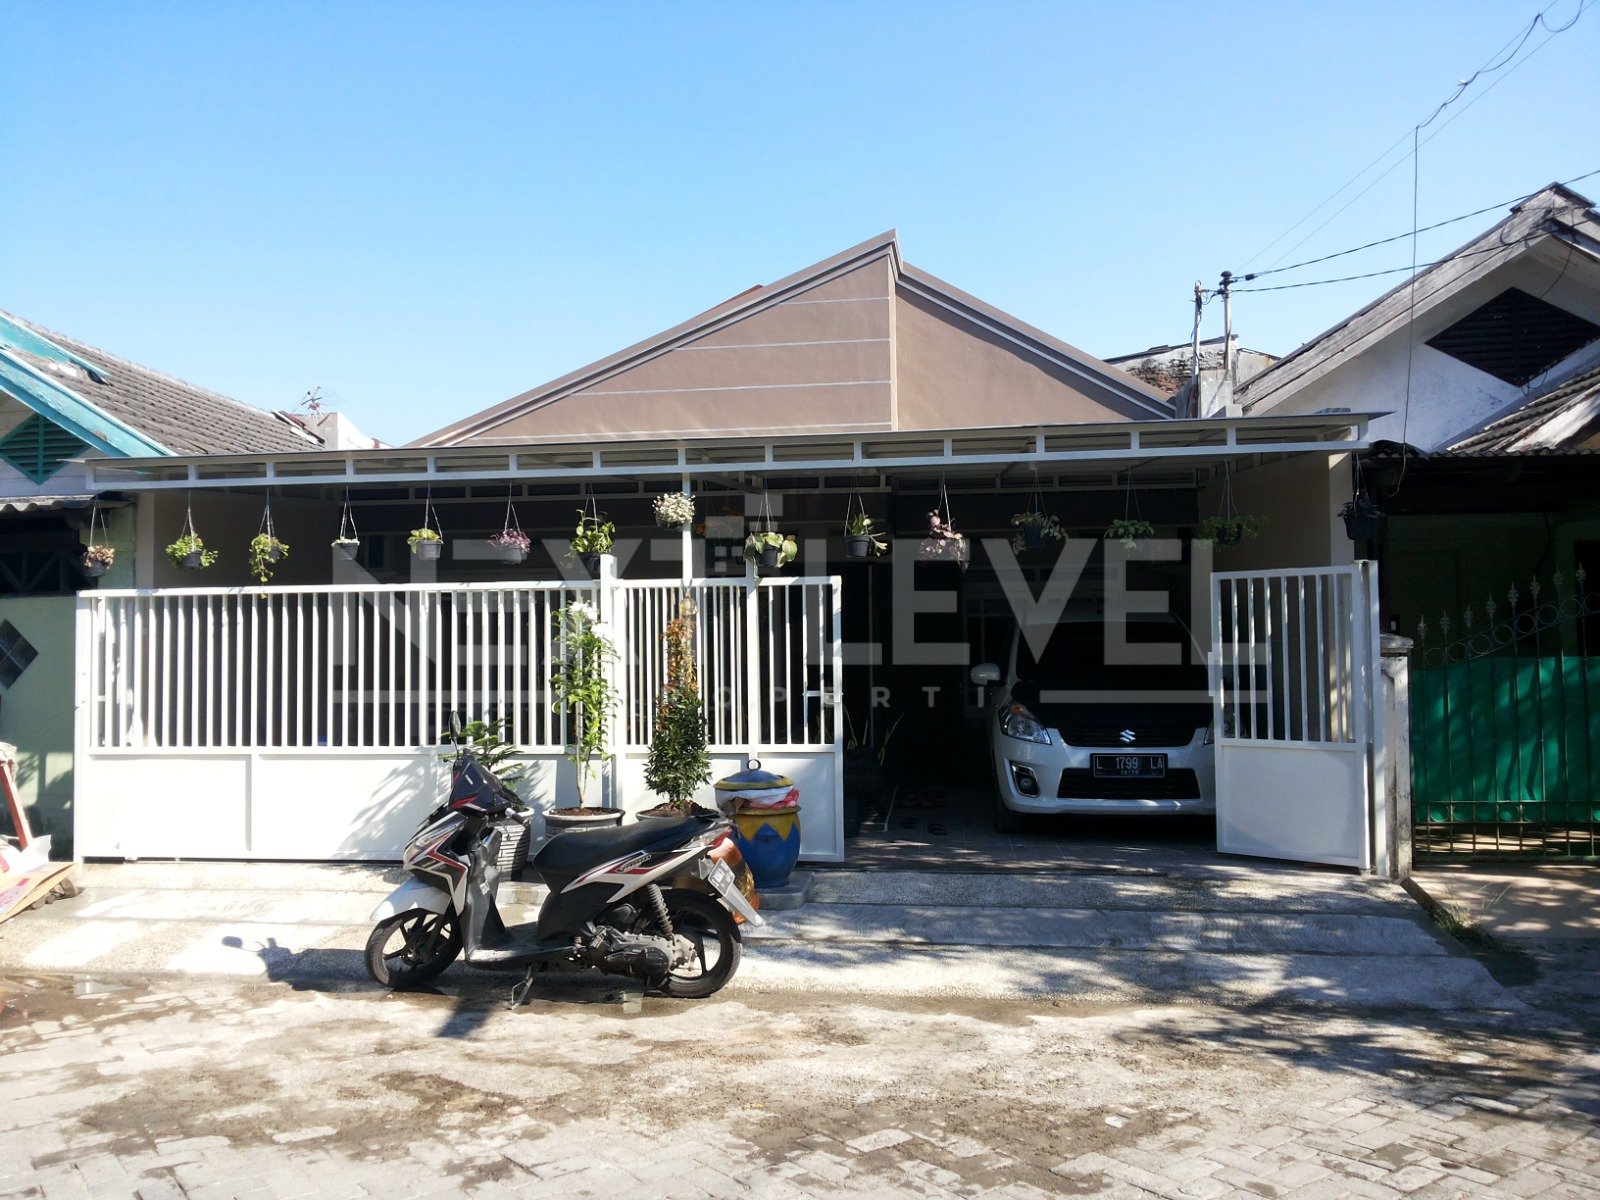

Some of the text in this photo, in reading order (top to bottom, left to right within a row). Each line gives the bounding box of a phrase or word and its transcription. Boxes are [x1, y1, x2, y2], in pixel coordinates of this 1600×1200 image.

[1096, 757, 1163, 770] L 1799 LA
